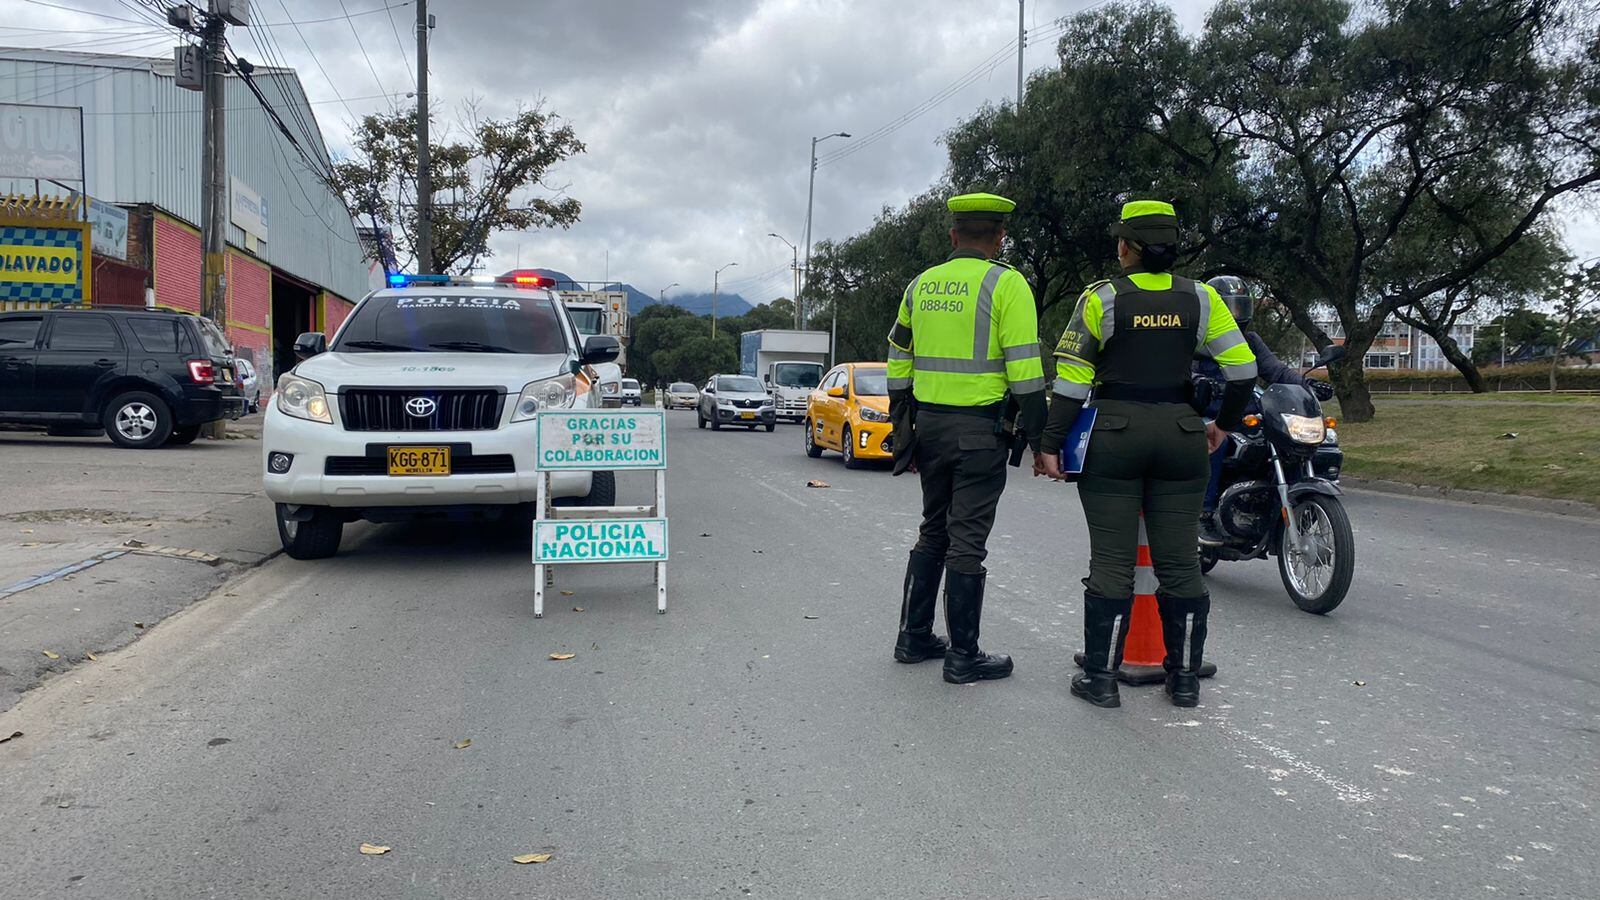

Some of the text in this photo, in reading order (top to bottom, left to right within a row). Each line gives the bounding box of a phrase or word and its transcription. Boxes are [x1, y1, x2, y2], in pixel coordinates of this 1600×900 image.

[919, 281, 969, 296] POLICIA
[397, 297, 521, 307] POLICIA
[457, 303, 521, 311] TRANSPORTE
[920, 299, 964, 312] 088450
[1133, 315, 1182, 327] POLICIA
[1078, 332, 1085, 342] Y
[567, 418, 636, 430] GRACIAS
[572, 433, 632, 445] POR SU
[544, 449, 659, 462] COLABORACION
[555, 524, 646, 541] POLICIA
[542, 541, 659, 558] NACIONAL
